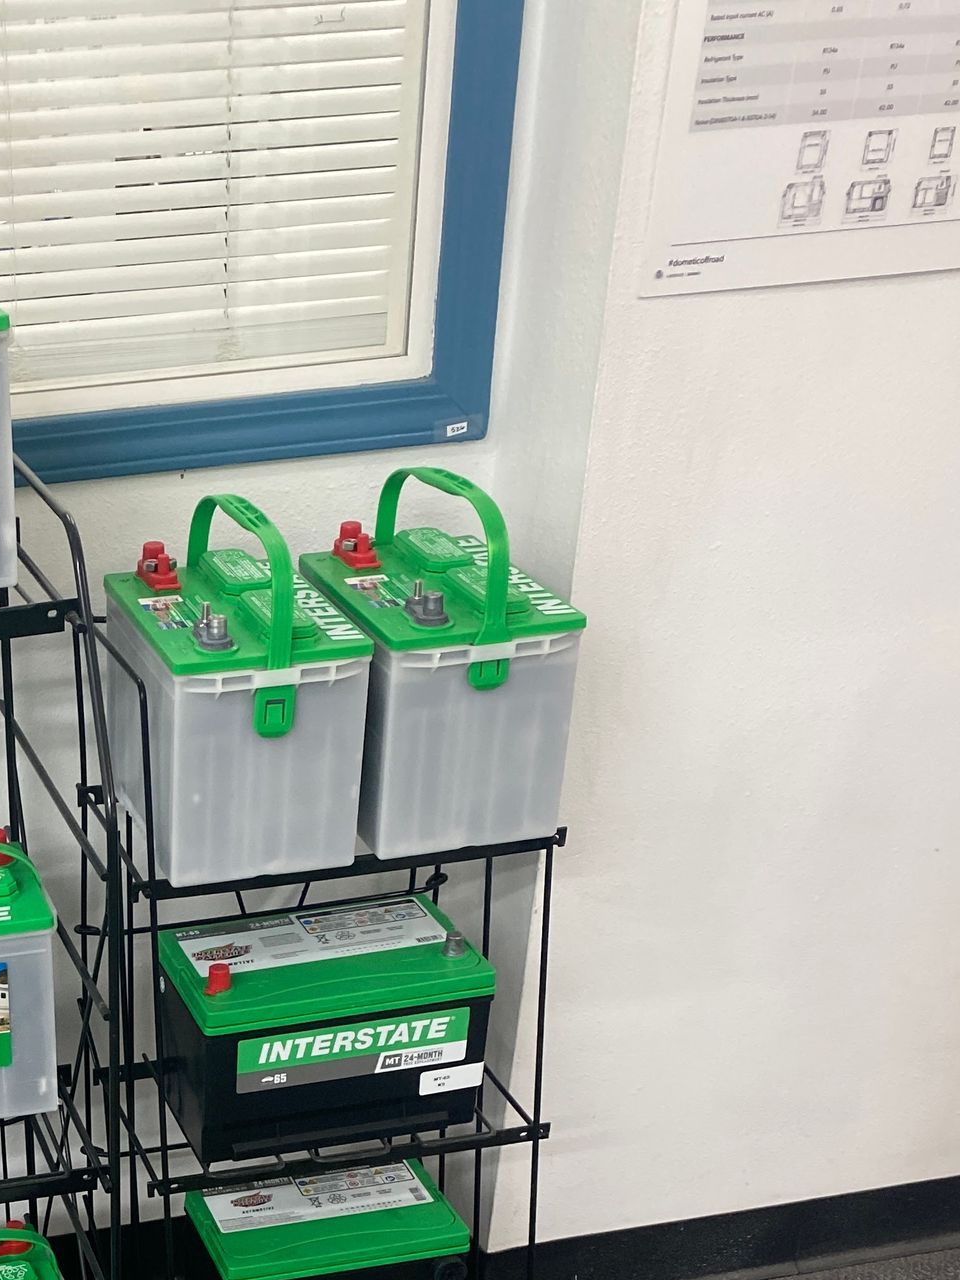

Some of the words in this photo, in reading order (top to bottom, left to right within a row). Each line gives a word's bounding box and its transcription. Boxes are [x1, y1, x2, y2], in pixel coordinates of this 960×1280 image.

[258, 1016, 451, 1065] INTERSTATE
[274, 1073, 287, 1084] 65
[385, 1056, 401, 1066] MT
[404, 1050, 443, 1062] 24-MONTH
